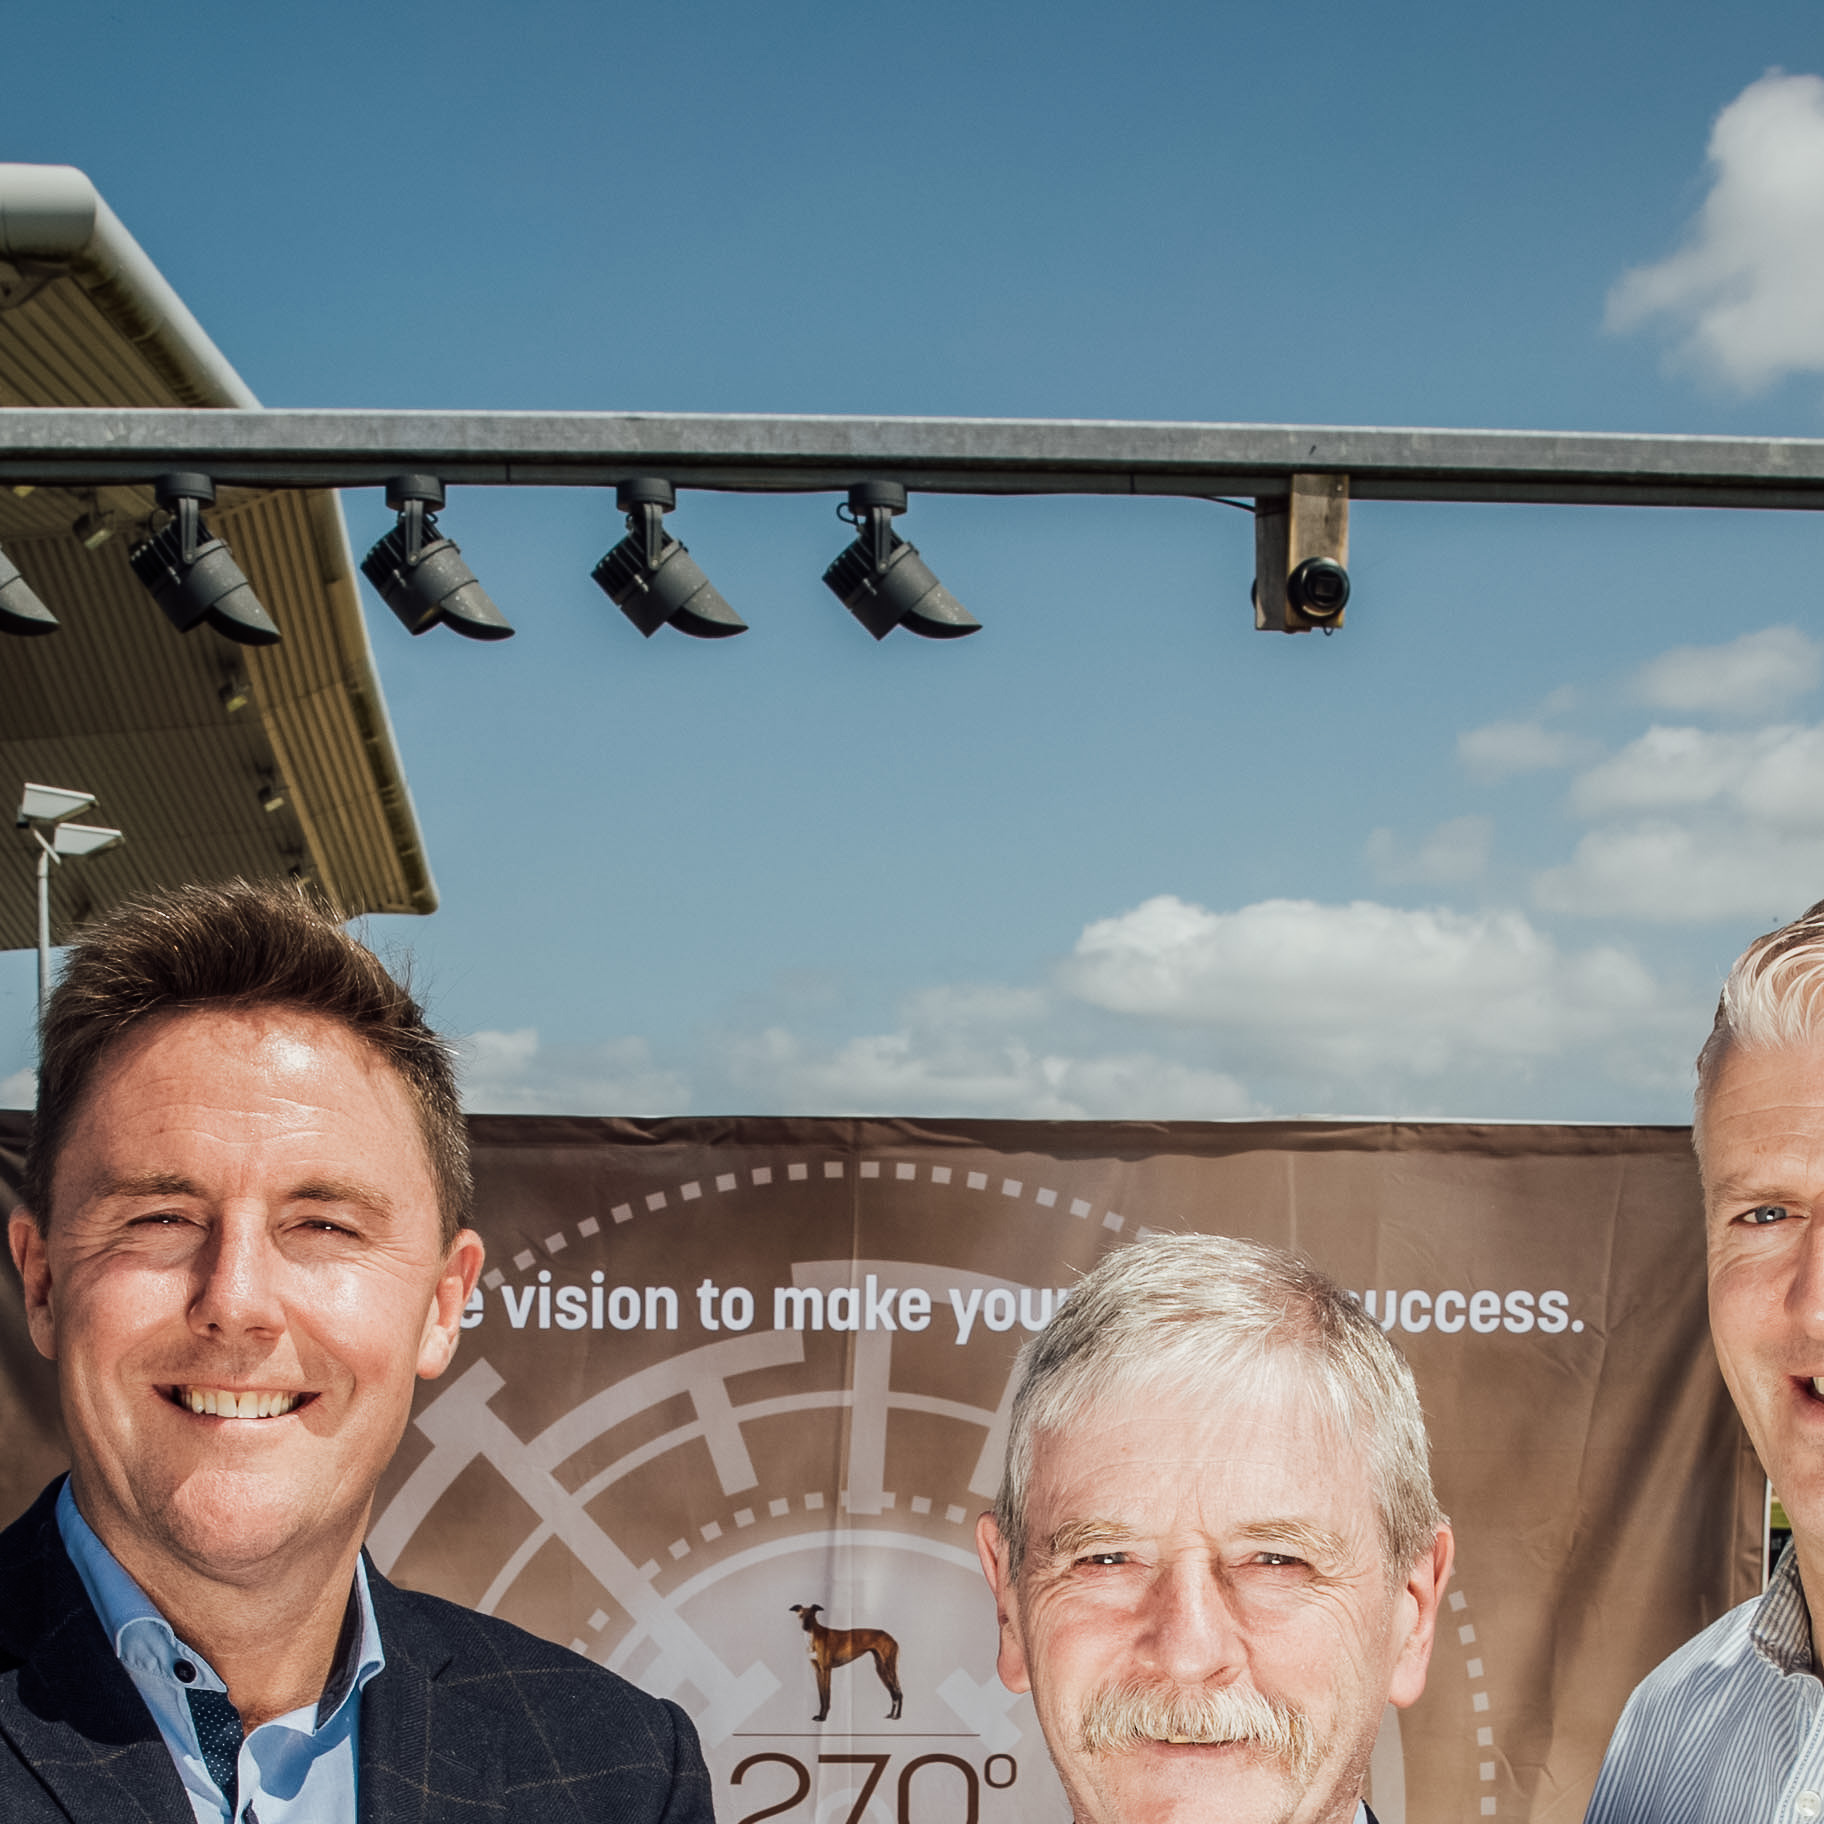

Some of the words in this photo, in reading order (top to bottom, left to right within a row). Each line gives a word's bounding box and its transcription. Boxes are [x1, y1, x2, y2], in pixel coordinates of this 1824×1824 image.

[500, 1269, 678, 1331] vision
[696, 1278, 755, 1332] to
[774, 1274, 932, 1332] make
[1346, 1289, 1585, 1334] uccess.
